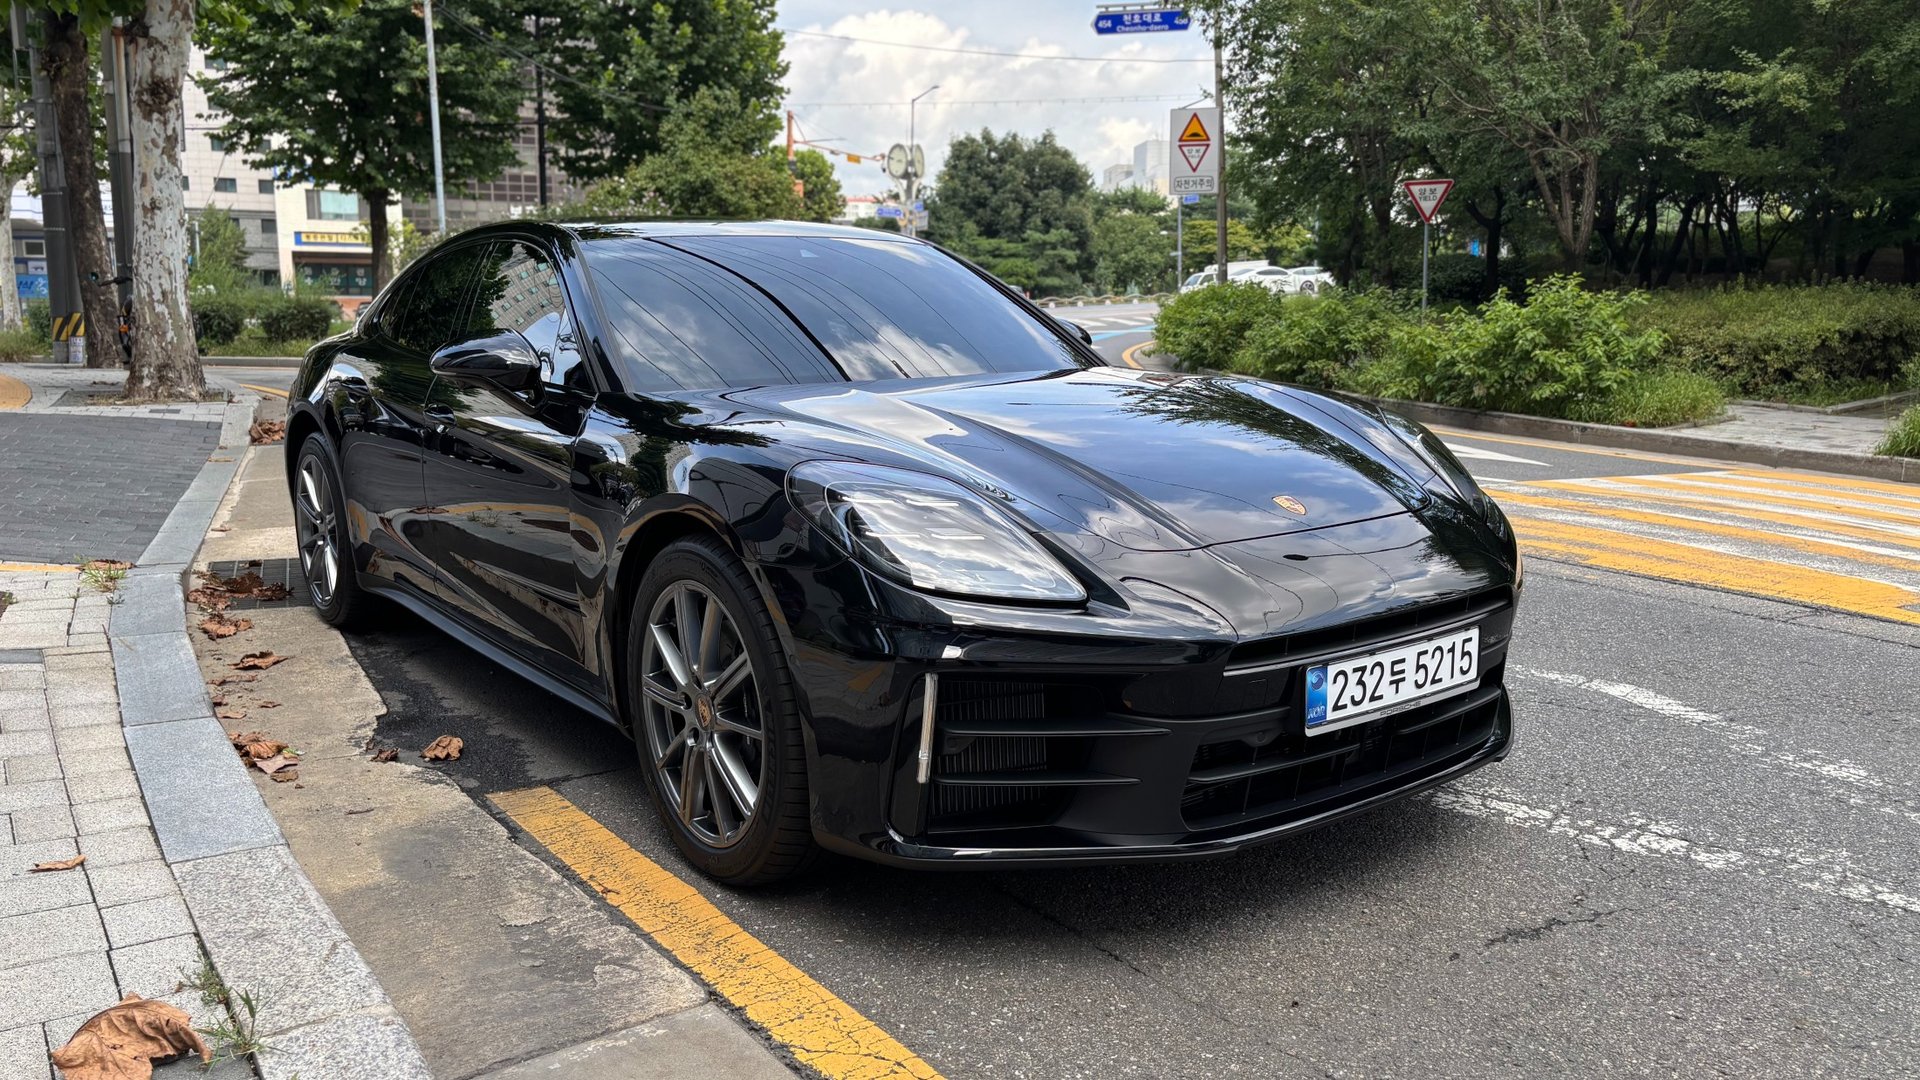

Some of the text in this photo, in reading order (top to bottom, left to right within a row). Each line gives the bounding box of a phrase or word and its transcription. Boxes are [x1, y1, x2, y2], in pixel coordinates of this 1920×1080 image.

[1098, 19, 1112, 28] 454
[1123, 13, 1163, 24] 천호대로
[1332, 636, 1473, 712] 232두 5215
